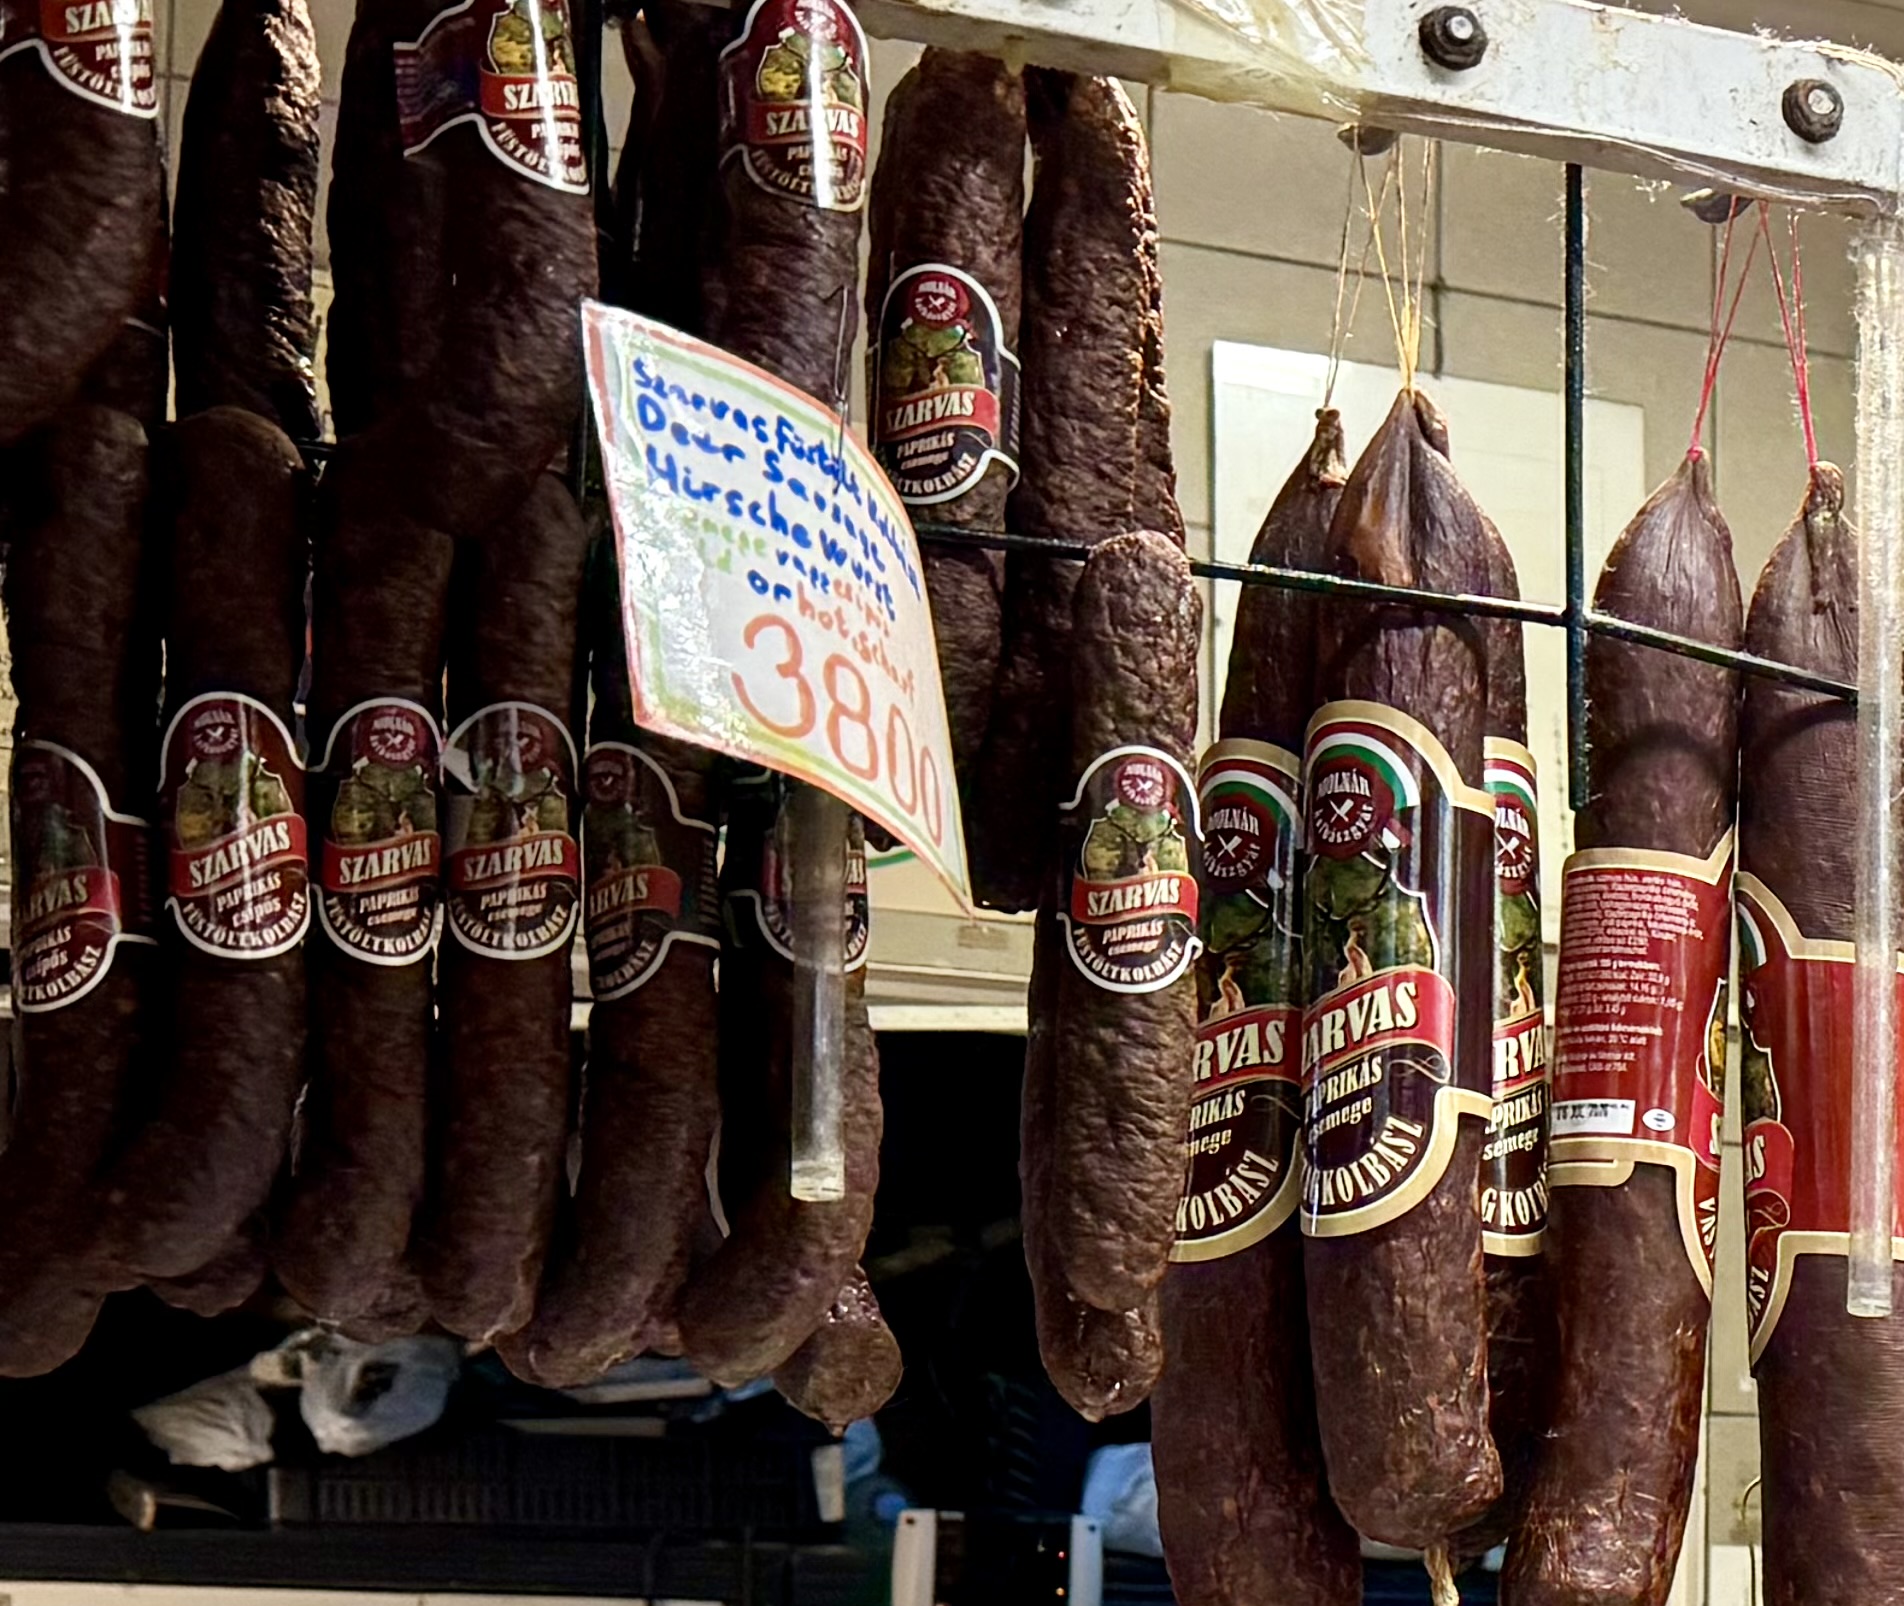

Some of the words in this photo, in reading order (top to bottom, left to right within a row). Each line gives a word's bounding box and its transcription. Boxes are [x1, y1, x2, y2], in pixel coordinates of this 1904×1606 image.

[766, 106, 860, 139] SZAVAS
[731, 612, 943, 849] 3800
[189, 821, 291, 889] SZARVAS
[339, 838, 433, 885] SZARVAS
[463, 838, 564, 882] SZARVAS
[1086, 879, 1182, 918] SZARVAS
[1101, 921, 1165, 945] PAPRIKÁS
[1193, 1018, 1286, 1082] RVAS
[1188, 1089, 1246, 1132] RIKÁS
